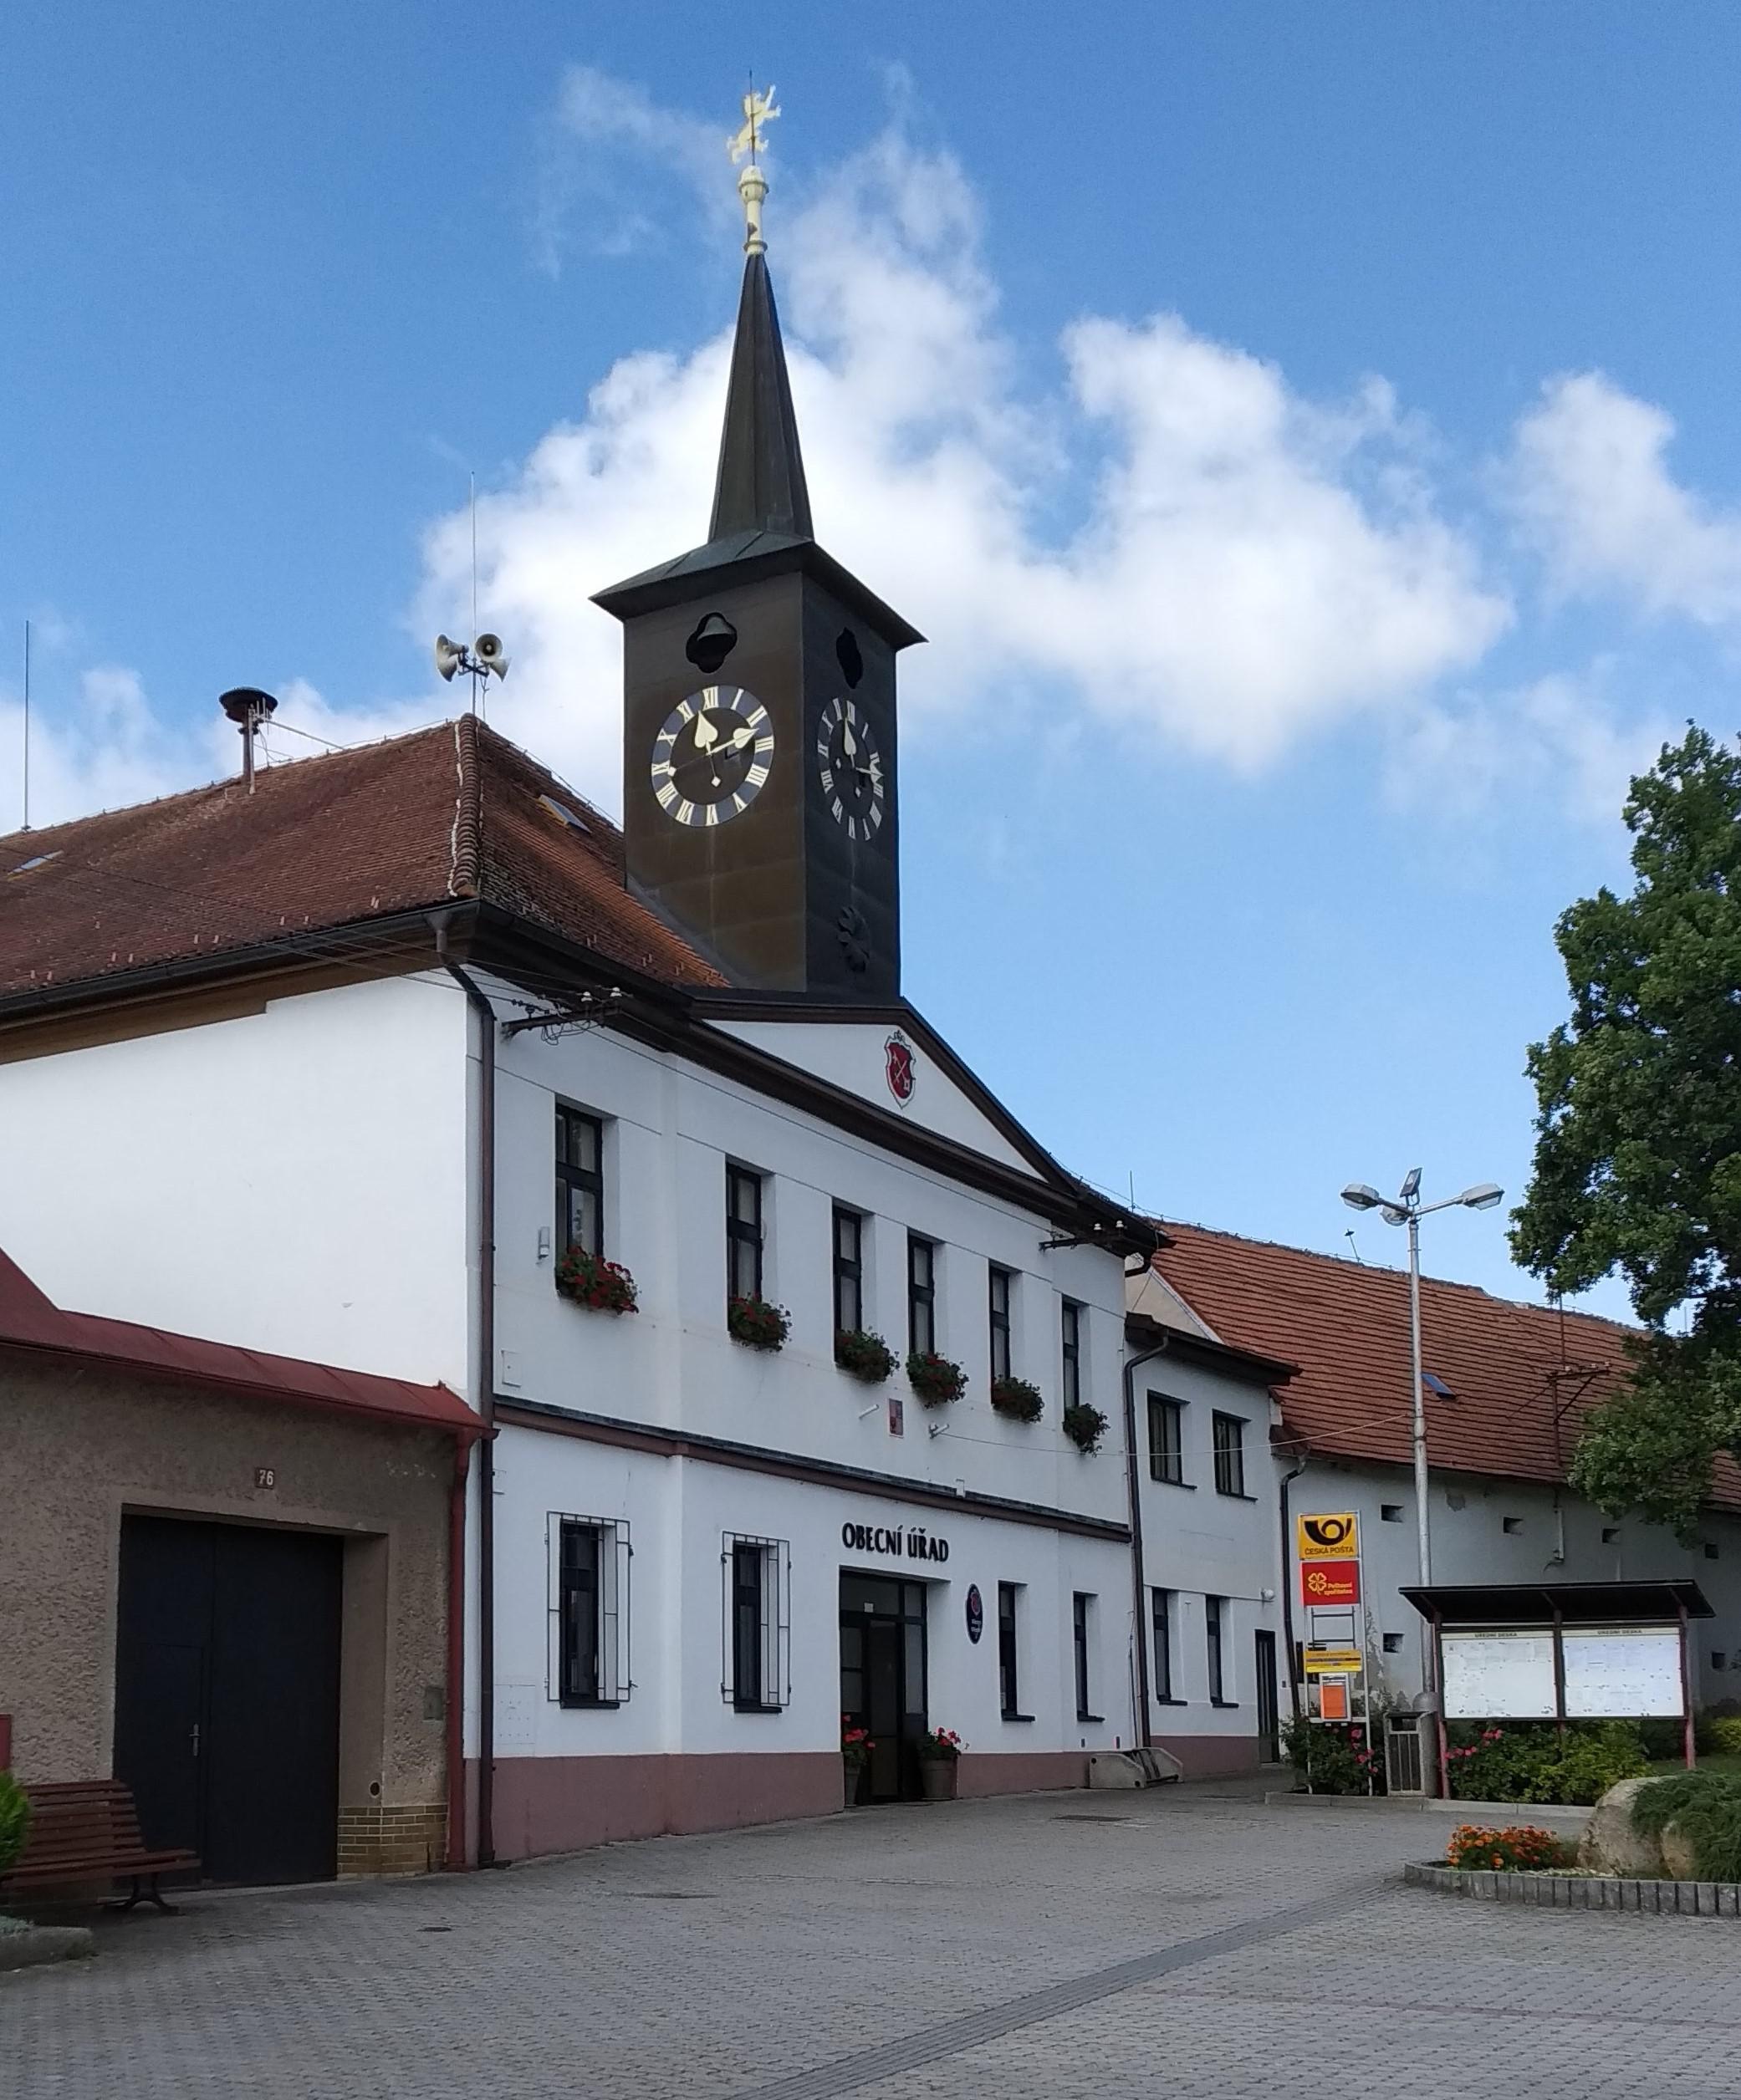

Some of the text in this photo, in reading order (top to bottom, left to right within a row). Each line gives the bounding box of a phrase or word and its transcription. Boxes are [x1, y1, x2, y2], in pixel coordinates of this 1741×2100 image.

[259, 1470, 274, 1486] 76
[842, 1522, 949, 1562] OBECNÍ ÚŘAD
[1304, 1545, 1354, 1555] ČESKÁ POŠTA
